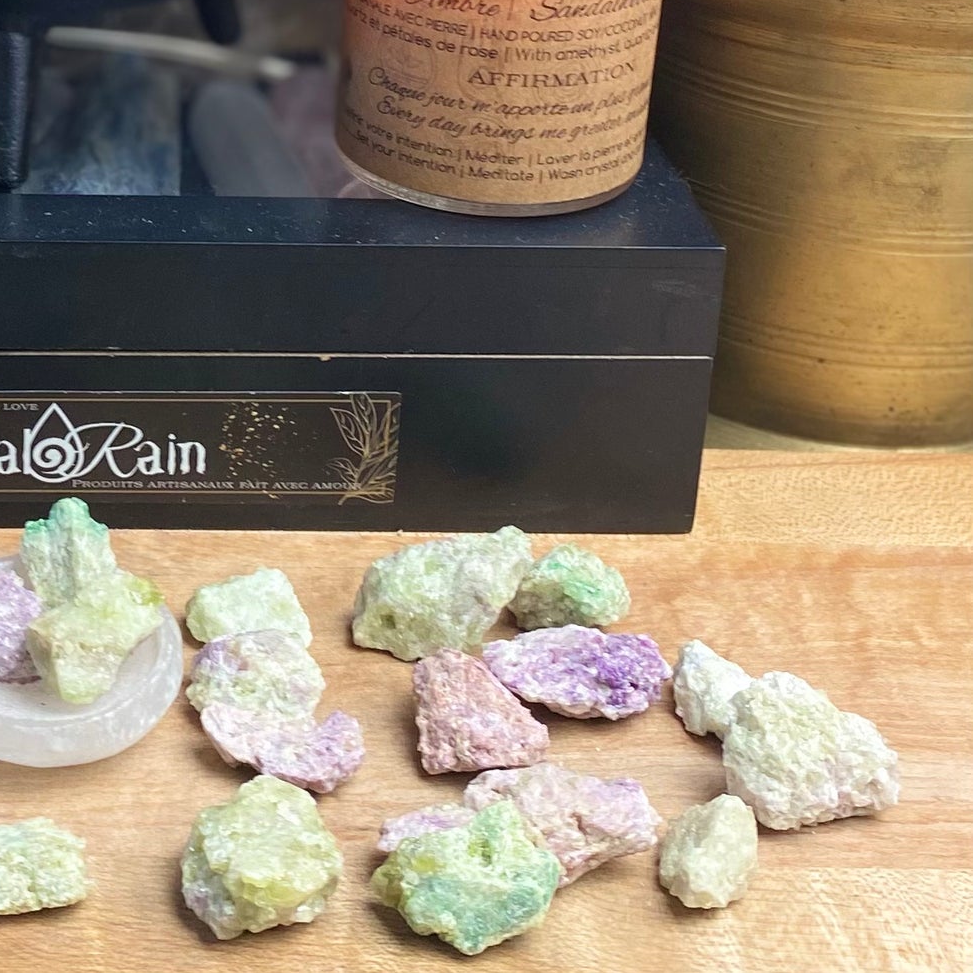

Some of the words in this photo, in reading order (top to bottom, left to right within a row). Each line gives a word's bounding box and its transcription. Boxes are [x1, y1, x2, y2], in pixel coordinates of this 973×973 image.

[382, 20, 433, 49] pétales
[435, 39, 457, 54] de
[459, 44, 499, 60] rose
[515, 46, 552, 62] With
[394, 6, 424, 27] AVEC
[426, 18, 468, 37] PIERRE
[479, 27, 519, 43] HAND
[521, 29, 574, 43] POURED
[368, 66, 427, 102] Chaque
[422, 91, 467, 110] jour
[467, 61, 635, 88] AFFIRMATION
[376, 95, 427, 130] Every
[428, 115, 468, 138] day
[470, 121, 538, 144] brings
[538, 127, 568, 140] me
[395, 132, 453, 158] intention
[398, 147, 456, 176] intention
[468, 165, 535, 182] Meditate
[547, 168, 583, 181] Wash
[3, 402, 39, 411] LOVE
[67, 421, 207, 478] Rain
[71, 479, 144, 490] PRODUITS
[146, 480, 236, 490] ARTISANAUX
[239, 480, 269, 490] FAIT
[271, 481, 310, 490] AVEC
